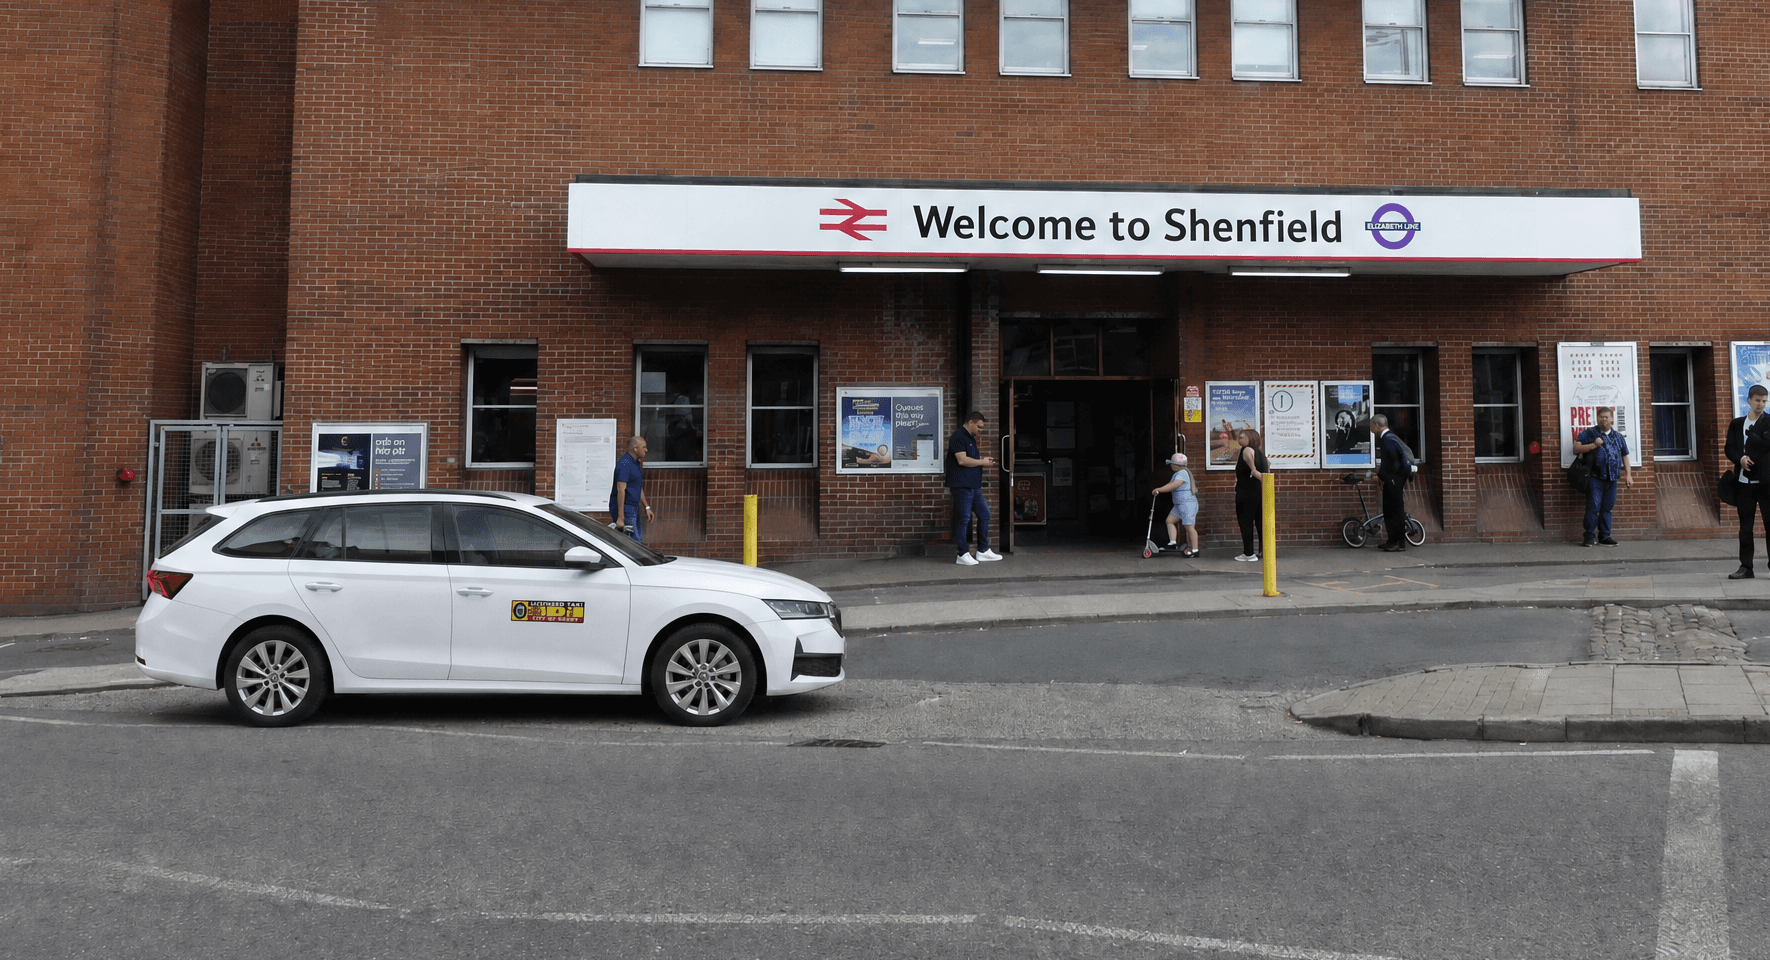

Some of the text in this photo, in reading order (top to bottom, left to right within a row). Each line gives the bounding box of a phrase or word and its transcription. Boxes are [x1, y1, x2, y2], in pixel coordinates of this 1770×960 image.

[913, 205, 1343, 244] Welcome to Shenfield
[1366, 222, 1403, 230] ELIZABETH
